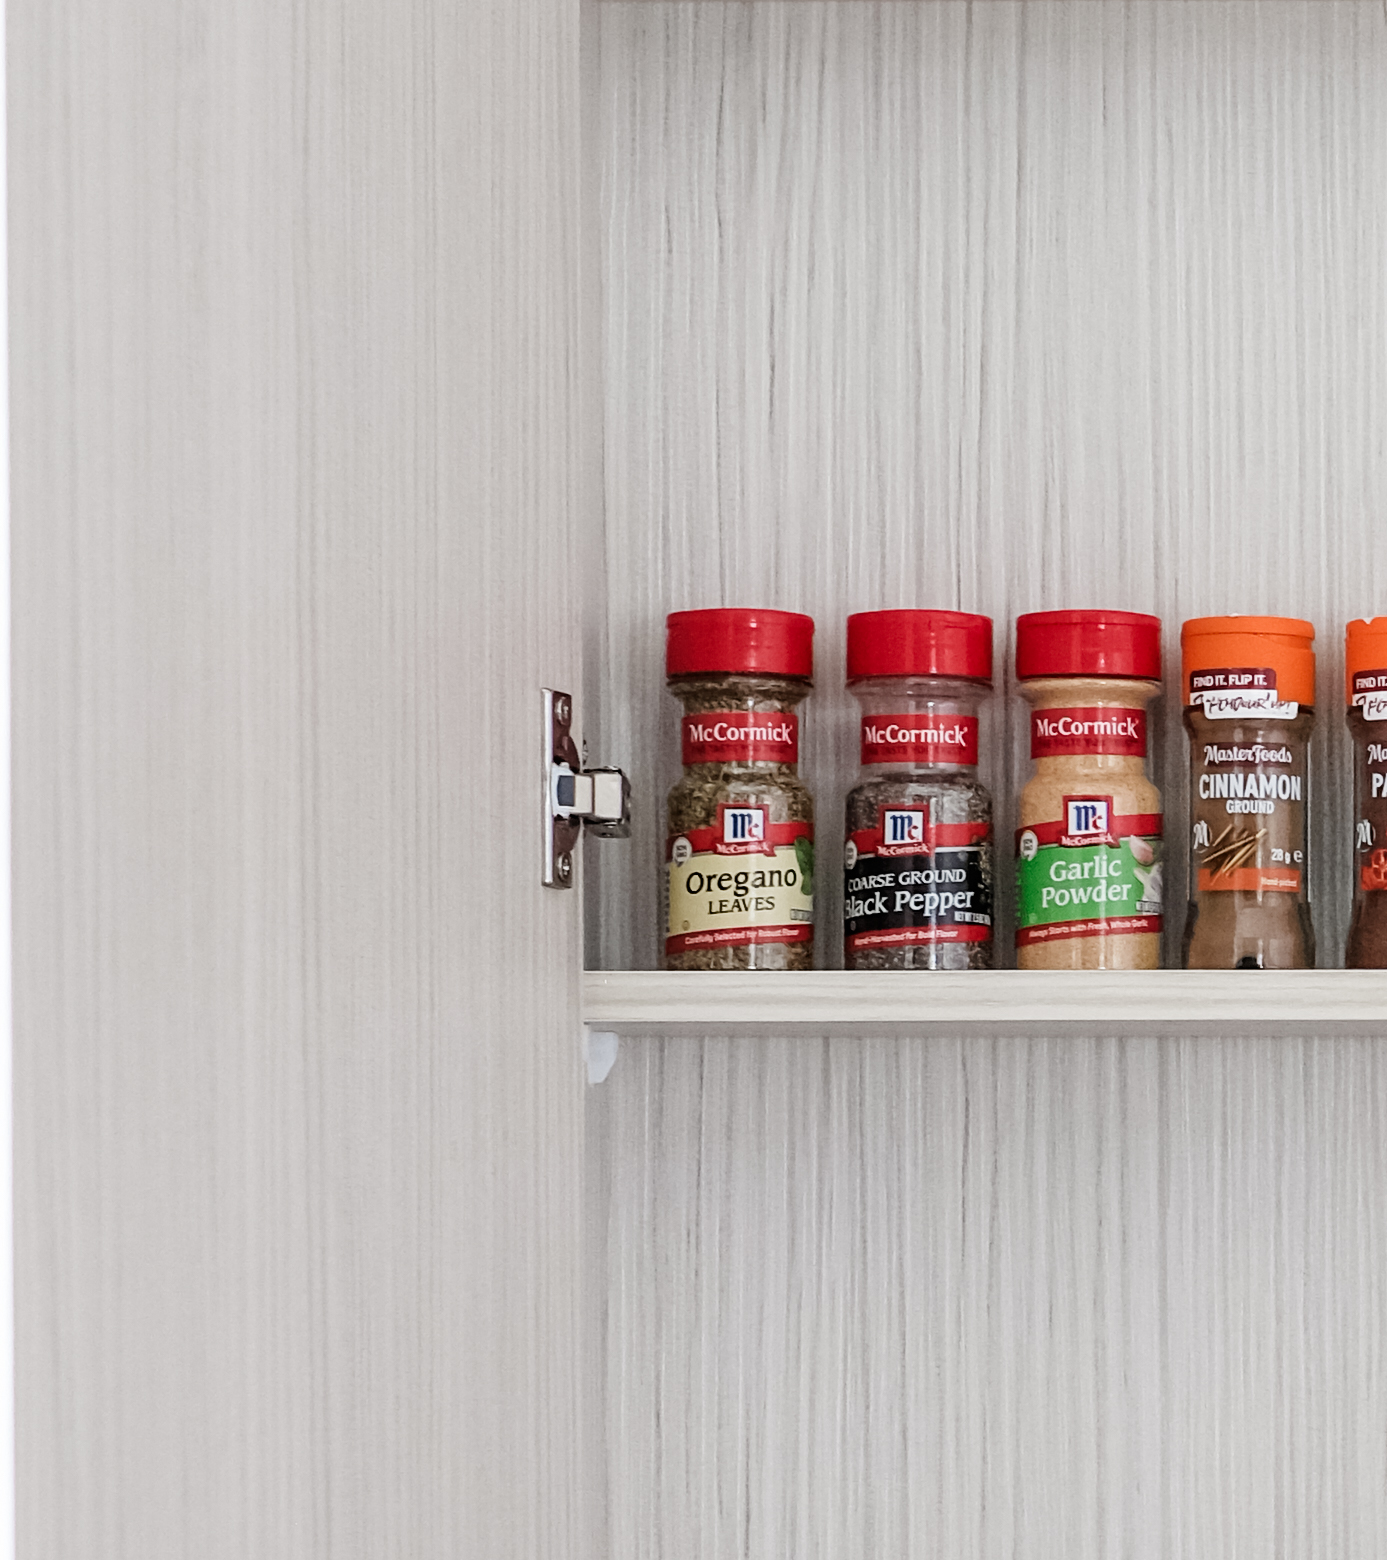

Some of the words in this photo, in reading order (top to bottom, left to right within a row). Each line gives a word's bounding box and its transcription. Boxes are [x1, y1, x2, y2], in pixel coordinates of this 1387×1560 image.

[690, 722, 793, 745] McCormick
[865, 723, 968, 747] McCormick
[1036, 717, 1139, 740] McCormick
[1204, 745, 1292, 767] MasterFoods
[1199, 773, 1301, 800] CINNAMON
[1226, 800, 1274, 814] GROUND
[715, 843, 770, 855] McCormick
[877, 843, 930, 857] McCormick
[1060, 833, 1116, 846] McCormick
[1050, 855, 1122, 882] Garlic
[686, 869, 797, 897] Oregano
[848, 874, 896, 893] COARSE
[898, 869, 967, 886] GROUND
[893, 890, 975, 917] Pepper
[1042, 879, 1132, 908] Powder
[708, 896, 775, 915] LEAVES
